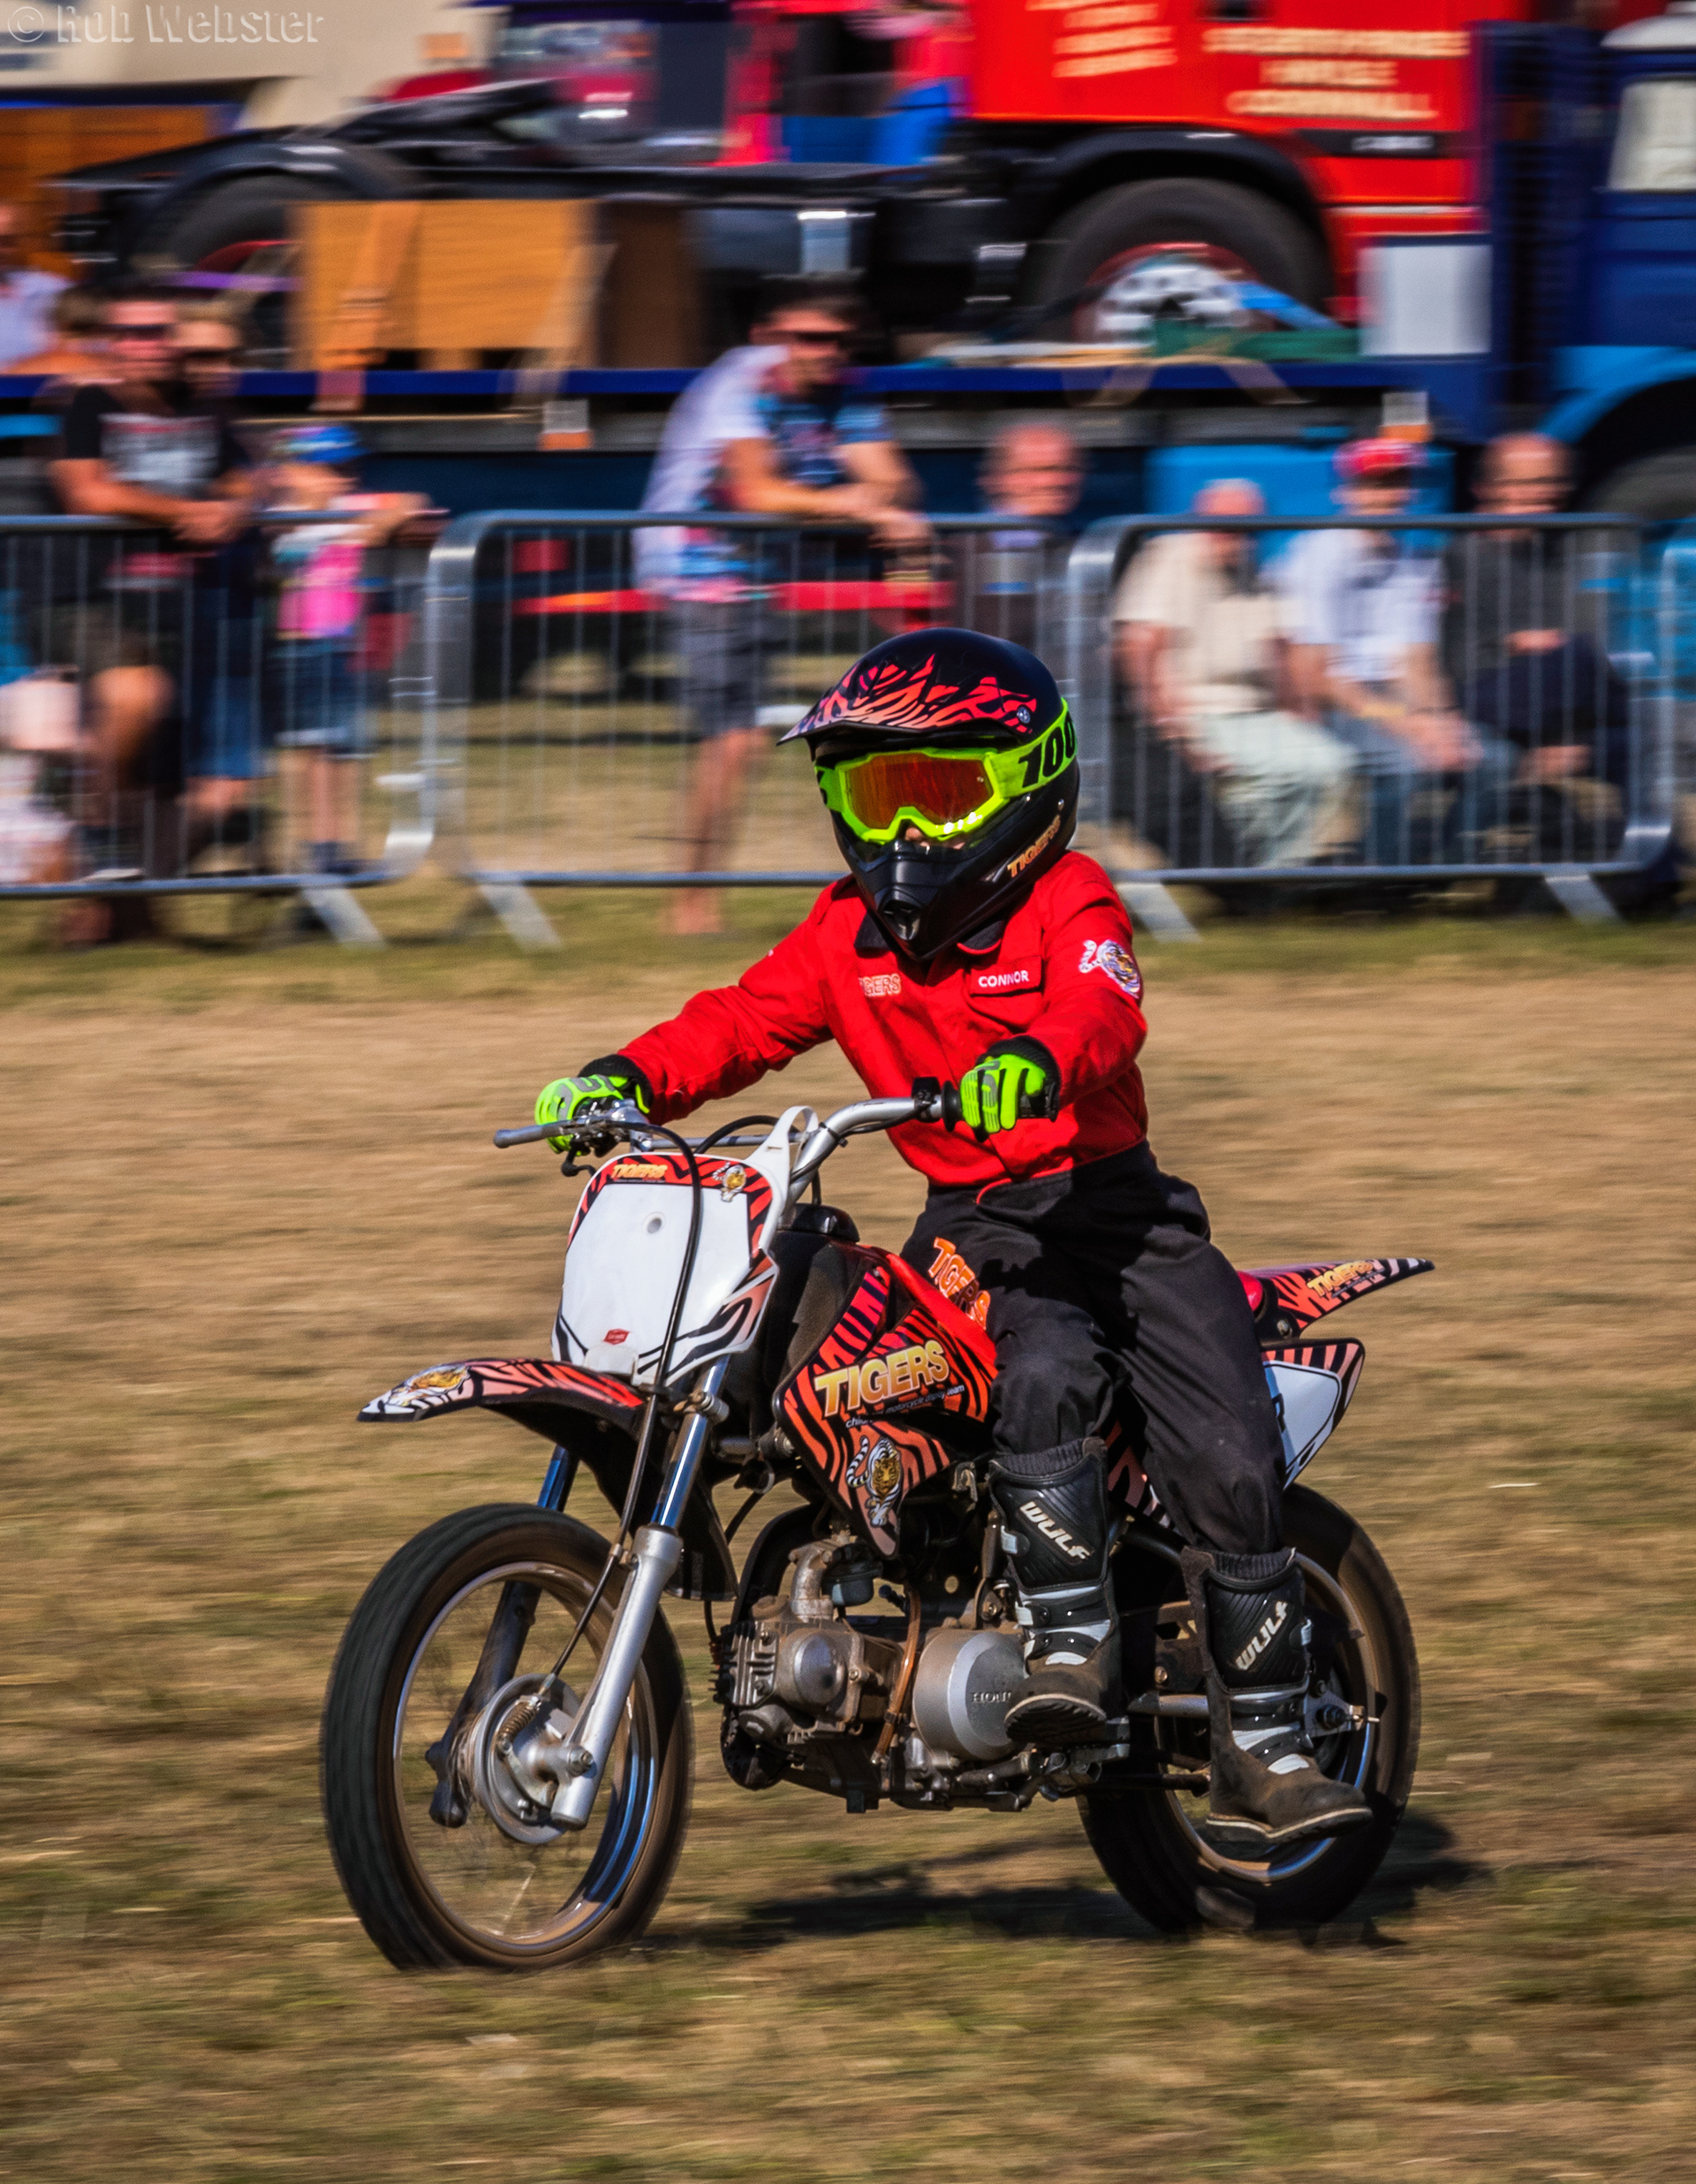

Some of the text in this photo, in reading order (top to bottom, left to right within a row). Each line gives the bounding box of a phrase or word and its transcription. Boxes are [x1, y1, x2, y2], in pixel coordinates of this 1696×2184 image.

[978, 970, 1029, 988] CONNOR
[610, 1164, 668, 1179] TIGERS
[928, 1237, 991, 1330] TIGERS
[1306, 1261, 1374, 1297] TIGERS
[814, 1339, 950, 1417] TIGERS
[1019, 1501, 1090, 1559] WULF
[1236, 1601, 1288, 1671] WULF
